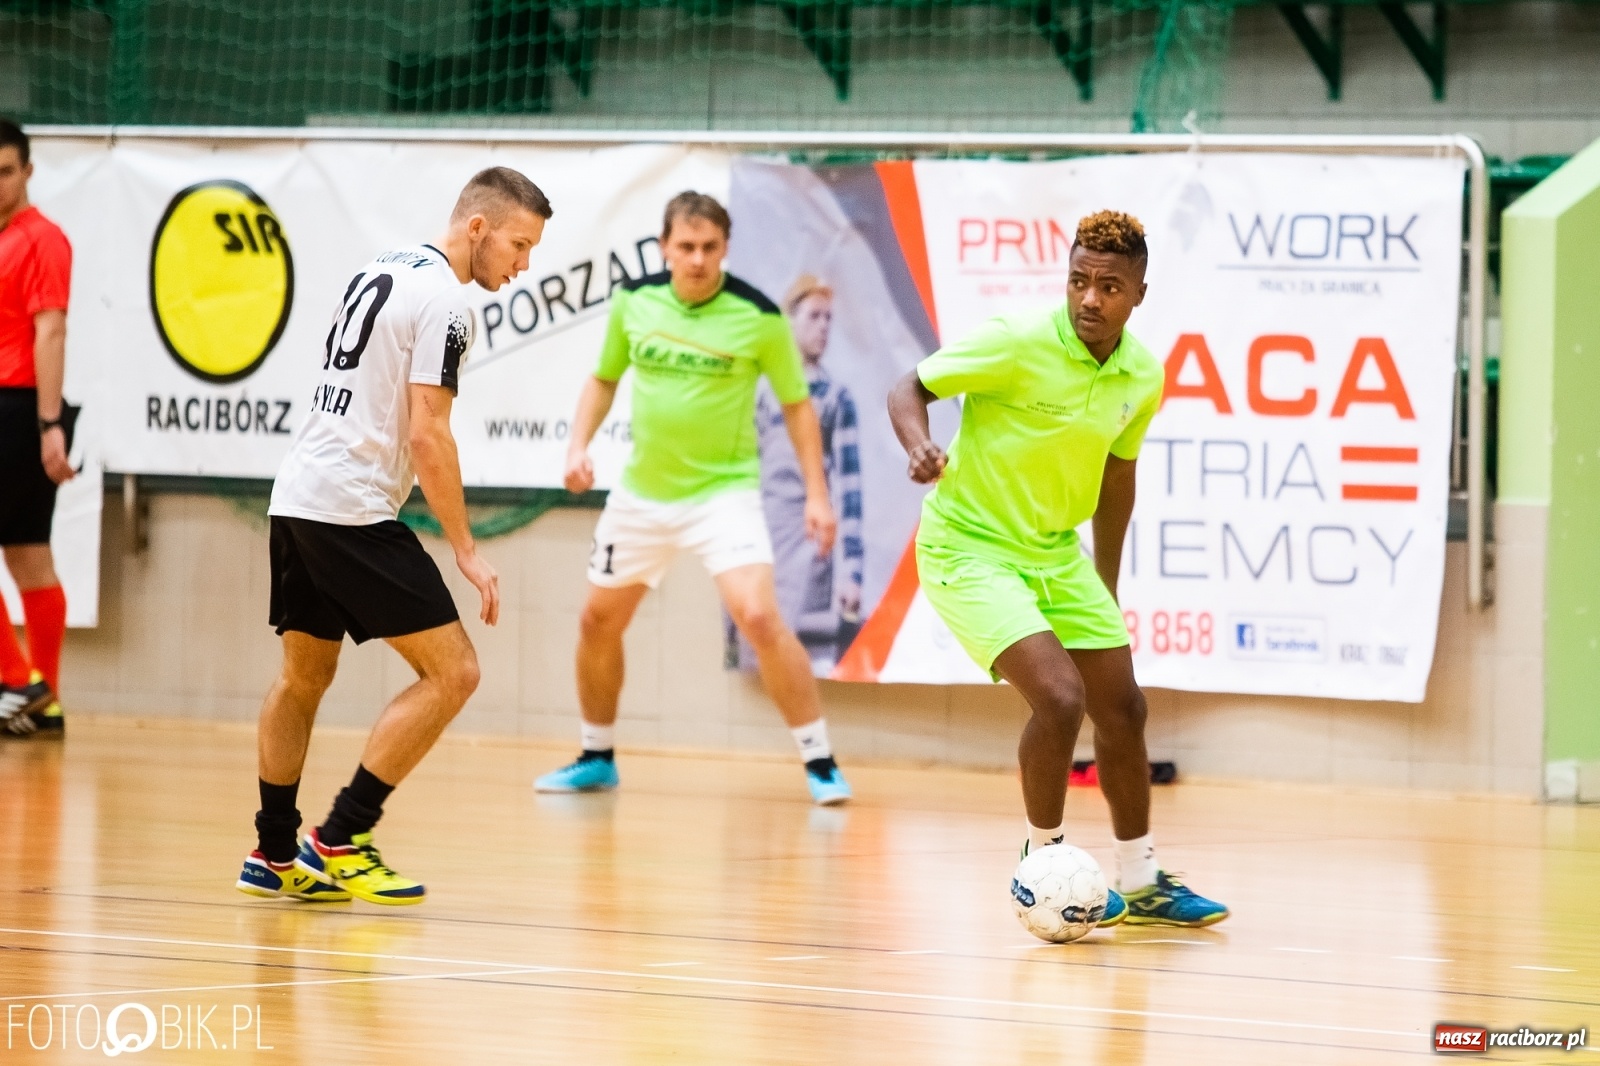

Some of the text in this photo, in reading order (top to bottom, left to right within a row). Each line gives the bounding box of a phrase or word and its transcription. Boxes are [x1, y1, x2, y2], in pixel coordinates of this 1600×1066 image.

[1227, 212, 1420, 261] WORK
[322, 272, 394, 371] 10
[1158, 333, 1417, 420] ACA
[146, 391, 292, 434] RACIBÓRZ
[1144, 437, 1325, 502] TRIA
[1130, 520, 1414, 587] IEMCY
[1152, 611, 1213, 656] 858
